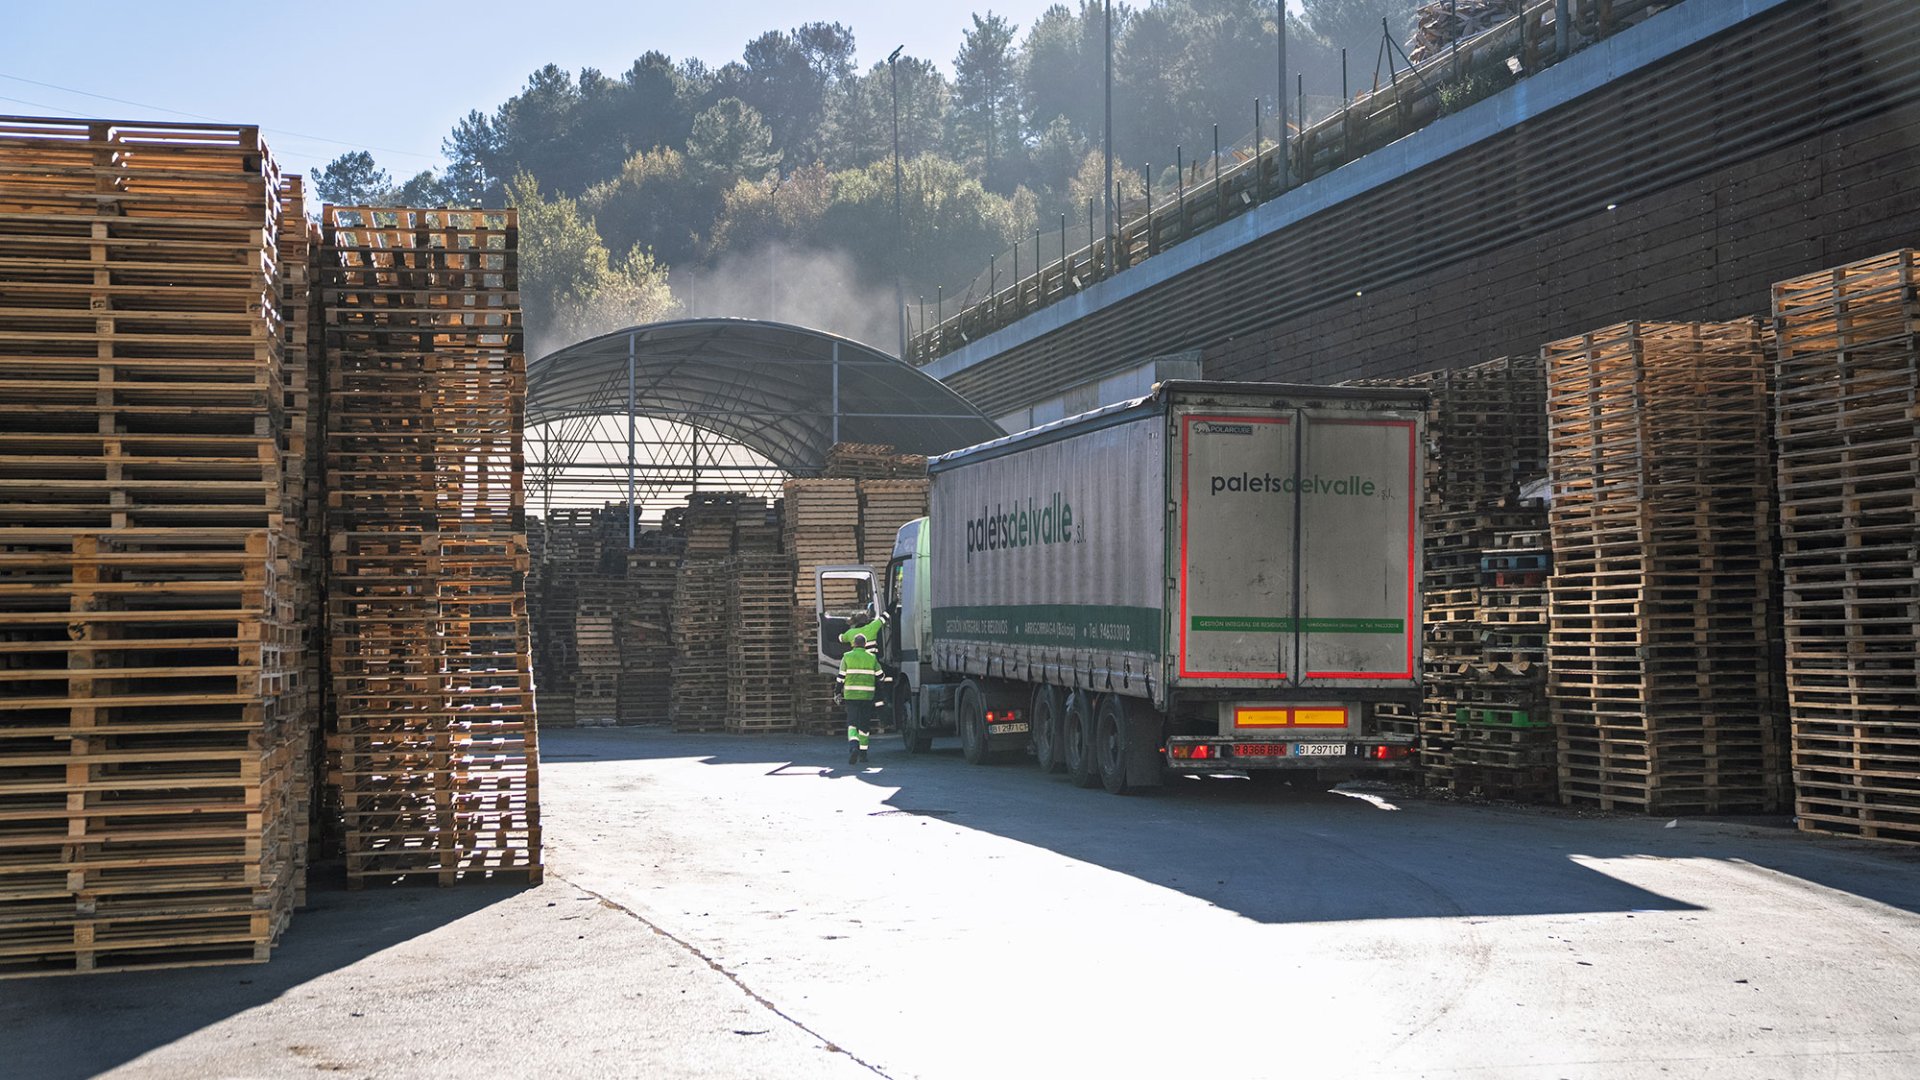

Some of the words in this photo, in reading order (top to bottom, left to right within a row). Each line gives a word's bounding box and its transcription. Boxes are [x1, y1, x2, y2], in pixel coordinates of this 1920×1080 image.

[1210, 425, 1251, 434] POLARCUBE
[1211, 472, 1375, 496] paletsdelvalle
[967, 491, 1072, 564] paletsdelvalle
[1100, 623, 1131, 642] 946333018
[1242, 745, 1265, 754] 8366
